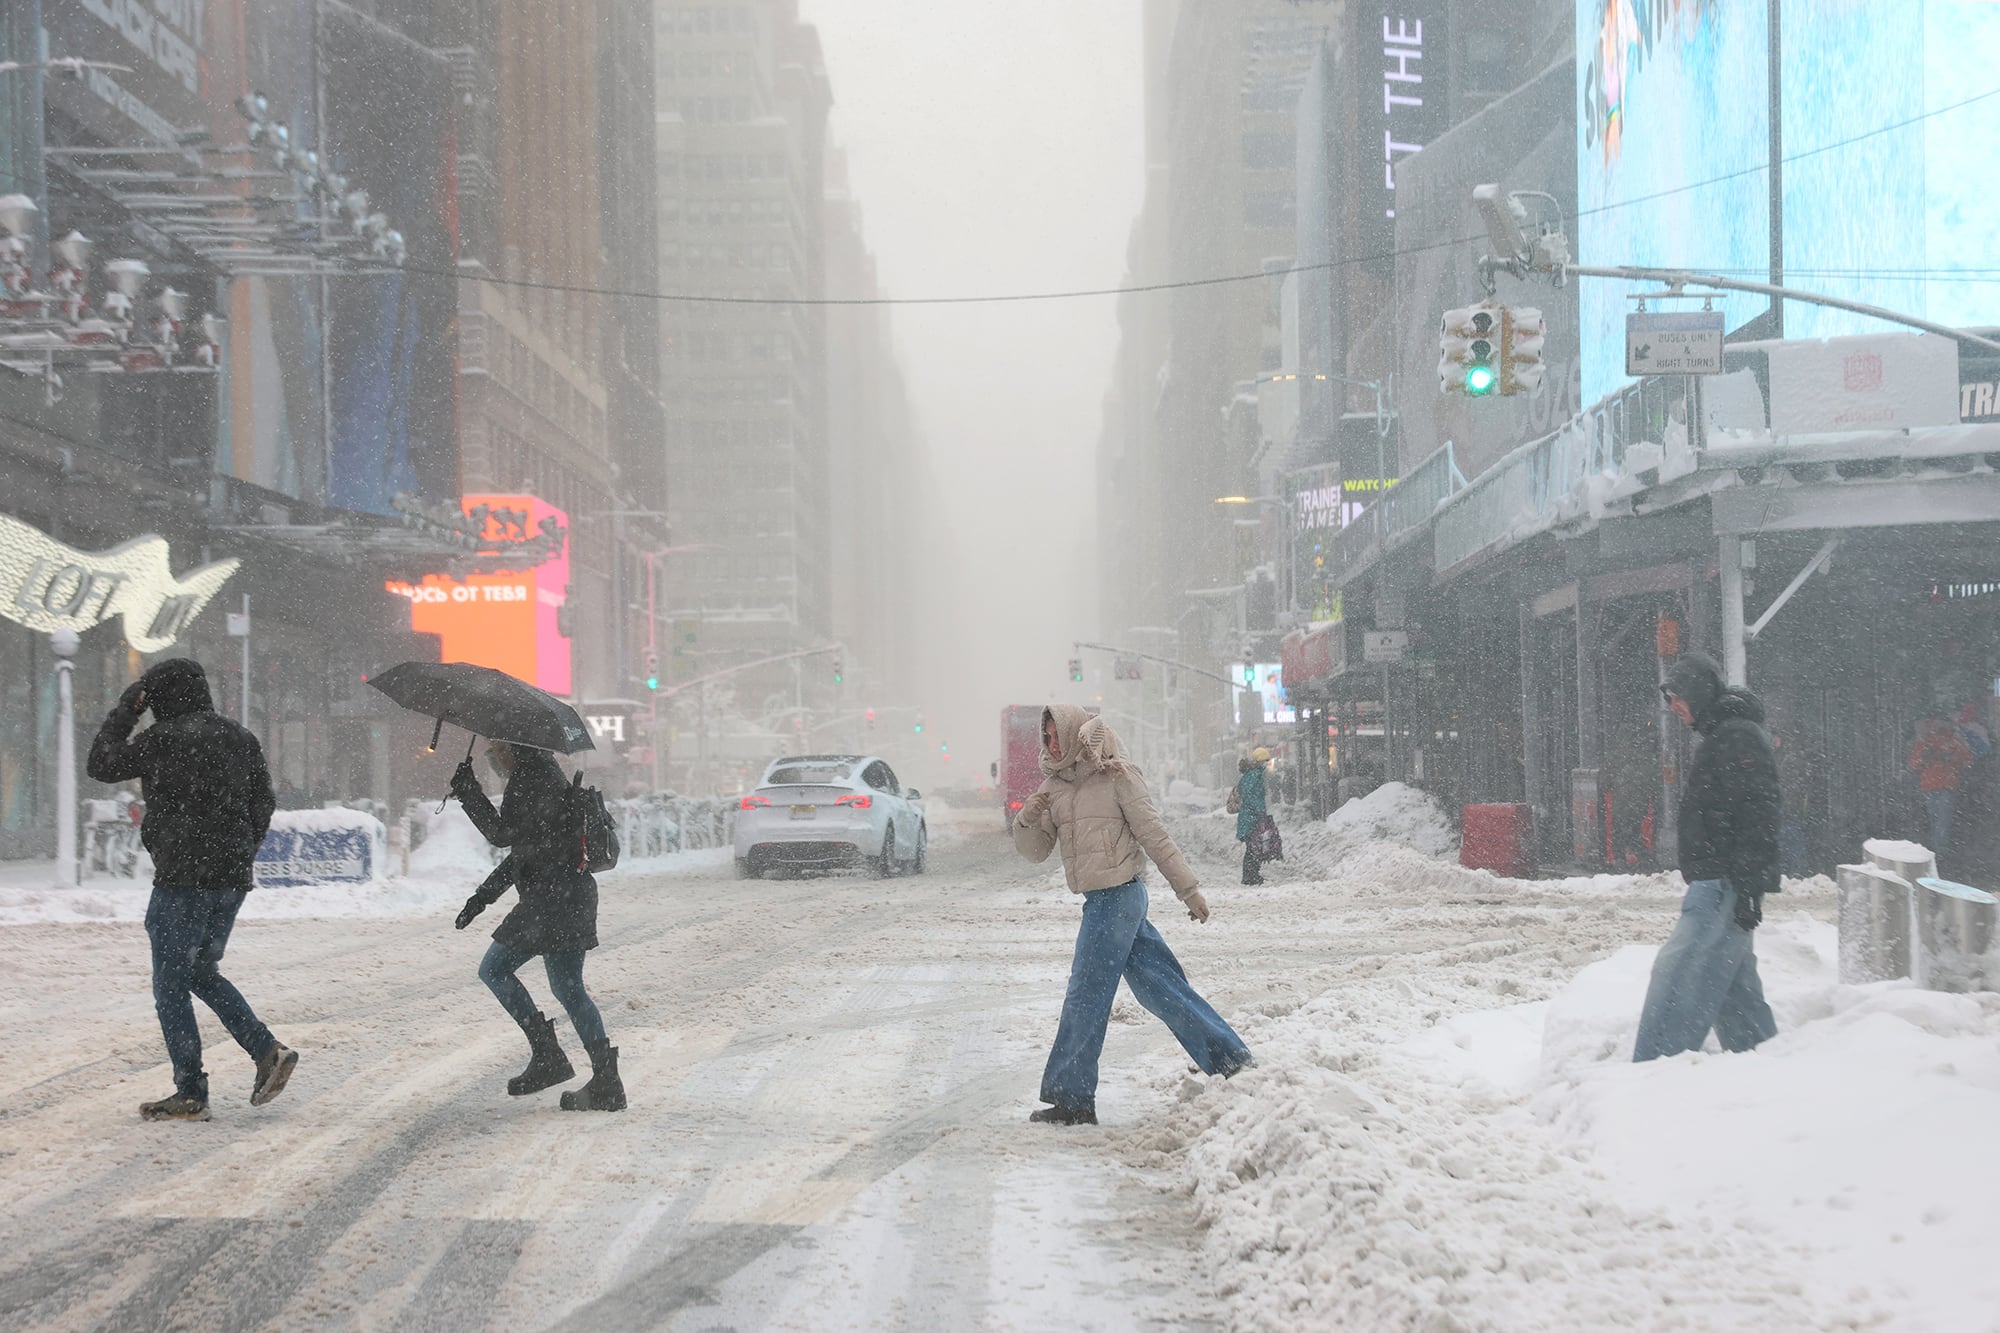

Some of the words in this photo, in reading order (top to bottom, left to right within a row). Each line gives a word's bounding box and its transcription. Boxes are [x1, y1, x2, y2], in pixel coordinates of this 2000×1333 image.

[1384, 15, 1422, 116] THE
[1658, 332, 1687, 343] BUSES
[1691, 332, 1713, 343] ONLY
[1687, 359, 1714, 368] TURNS
[451, 585, 479, 602] ОТ
[482, 585, 527, 602] ТЕБЯ
